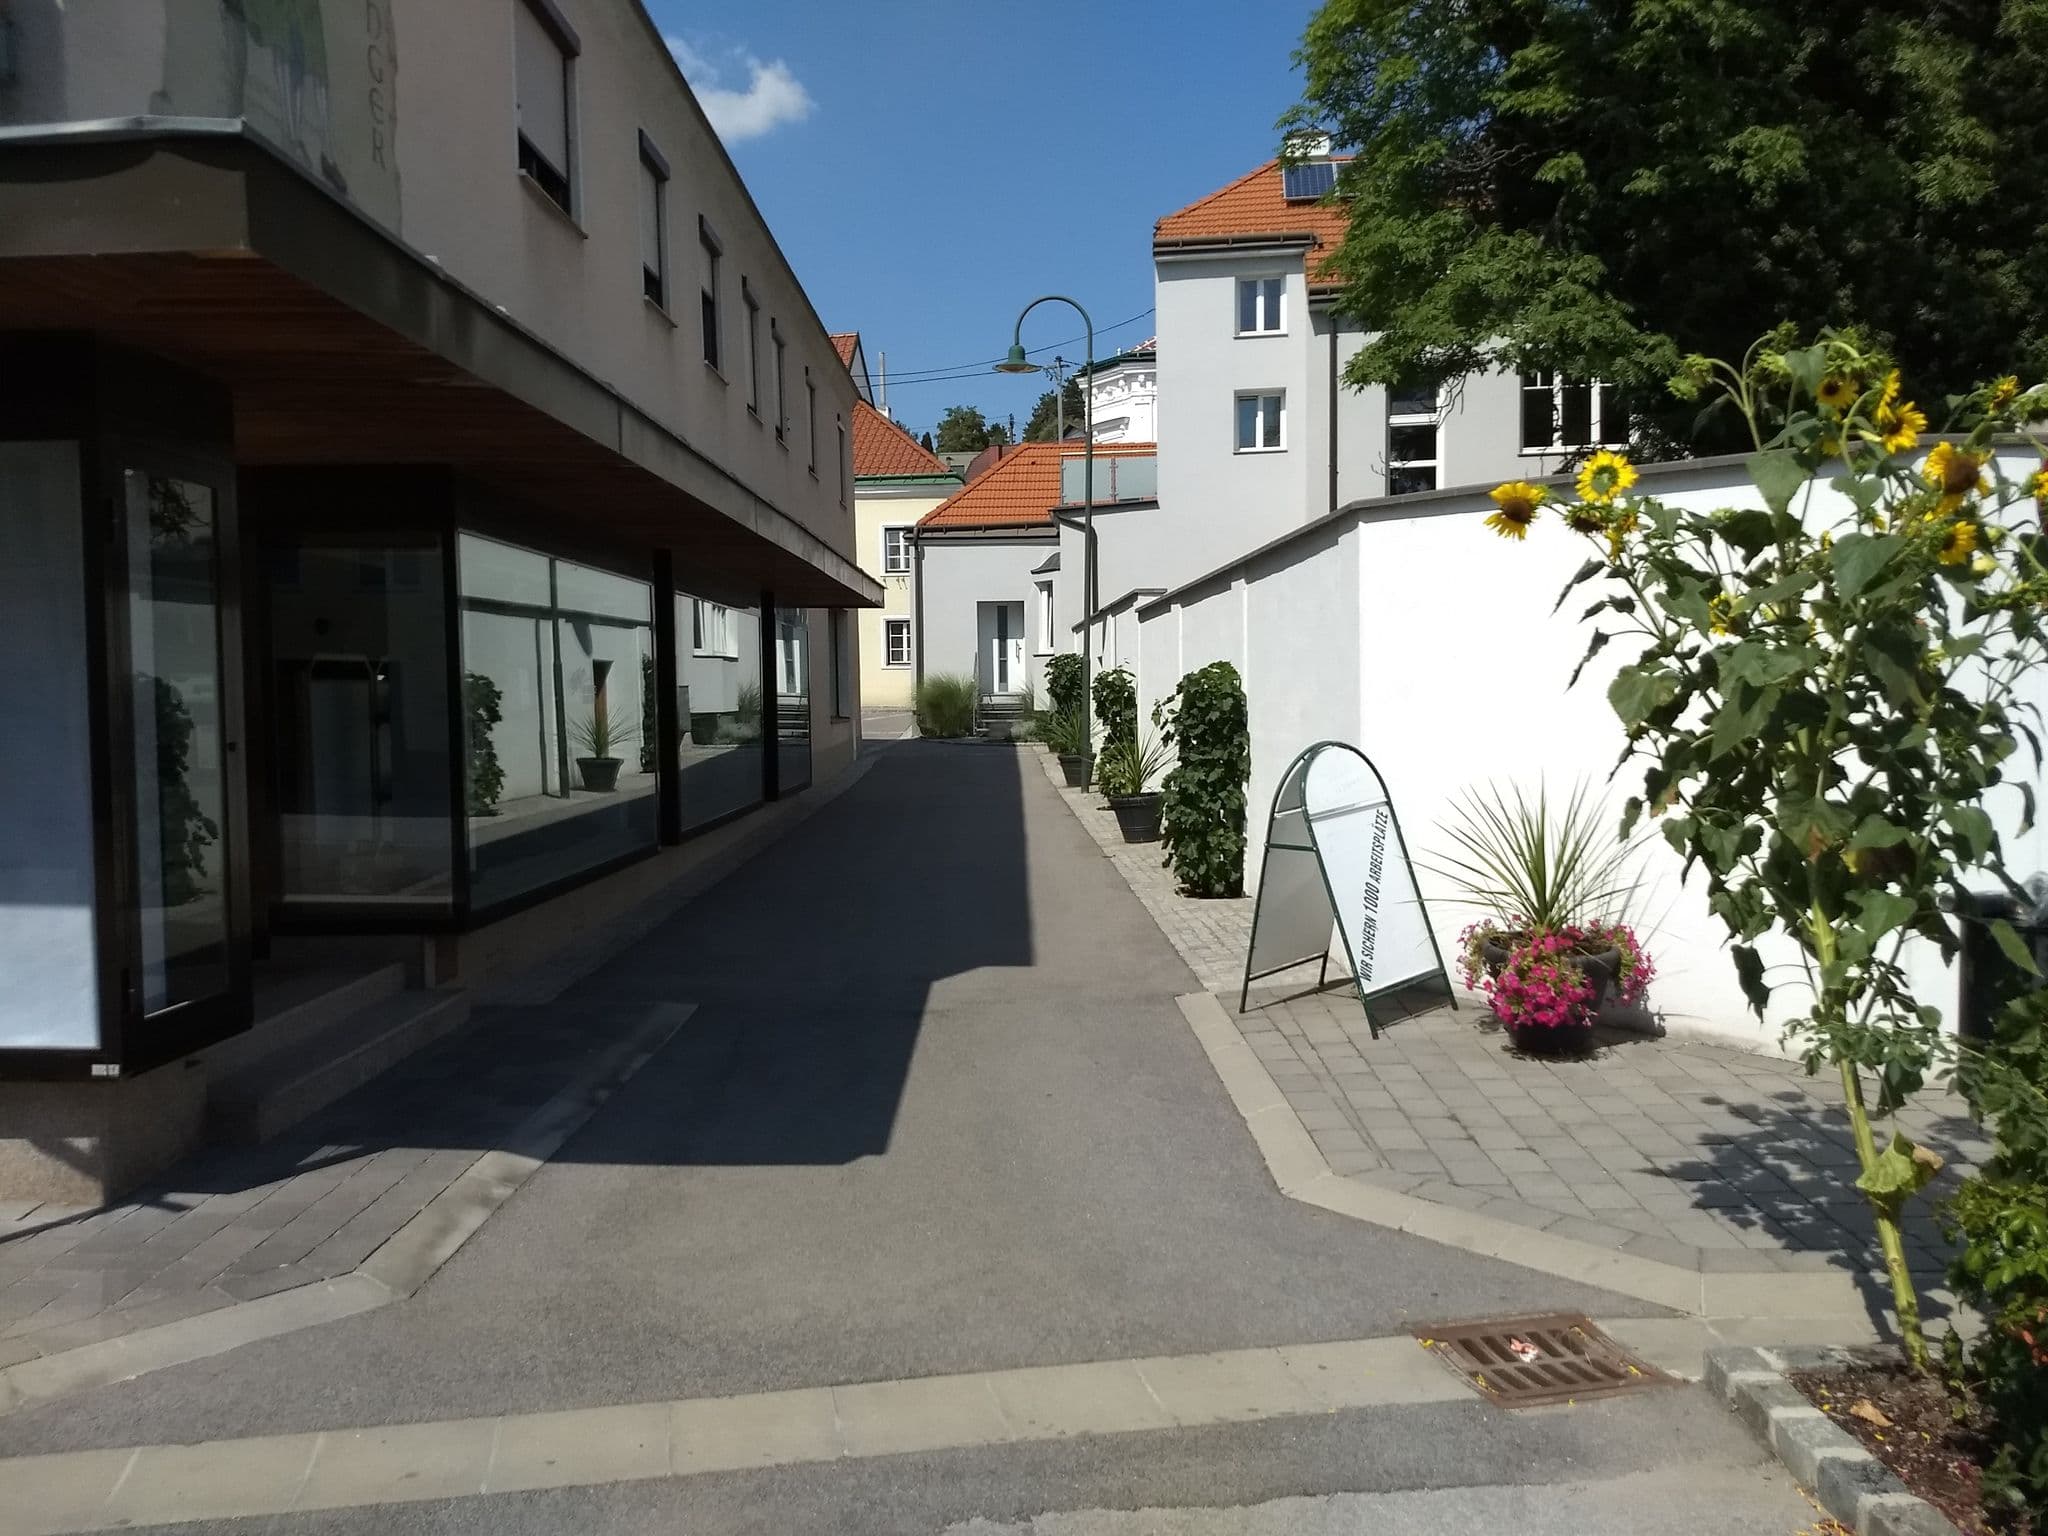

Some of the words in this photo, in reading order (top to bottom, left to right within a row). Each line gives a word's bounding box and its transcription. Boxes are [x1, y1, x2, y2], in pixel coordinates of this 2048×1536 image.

[1369, 809, 1388, 884] ARBEITSPLÄTZE
[1363, 881, 1379, 914] 1000
[1361, 915, 1377, 960] SICHERN
[1360, 960, 1372, 982] WIR
